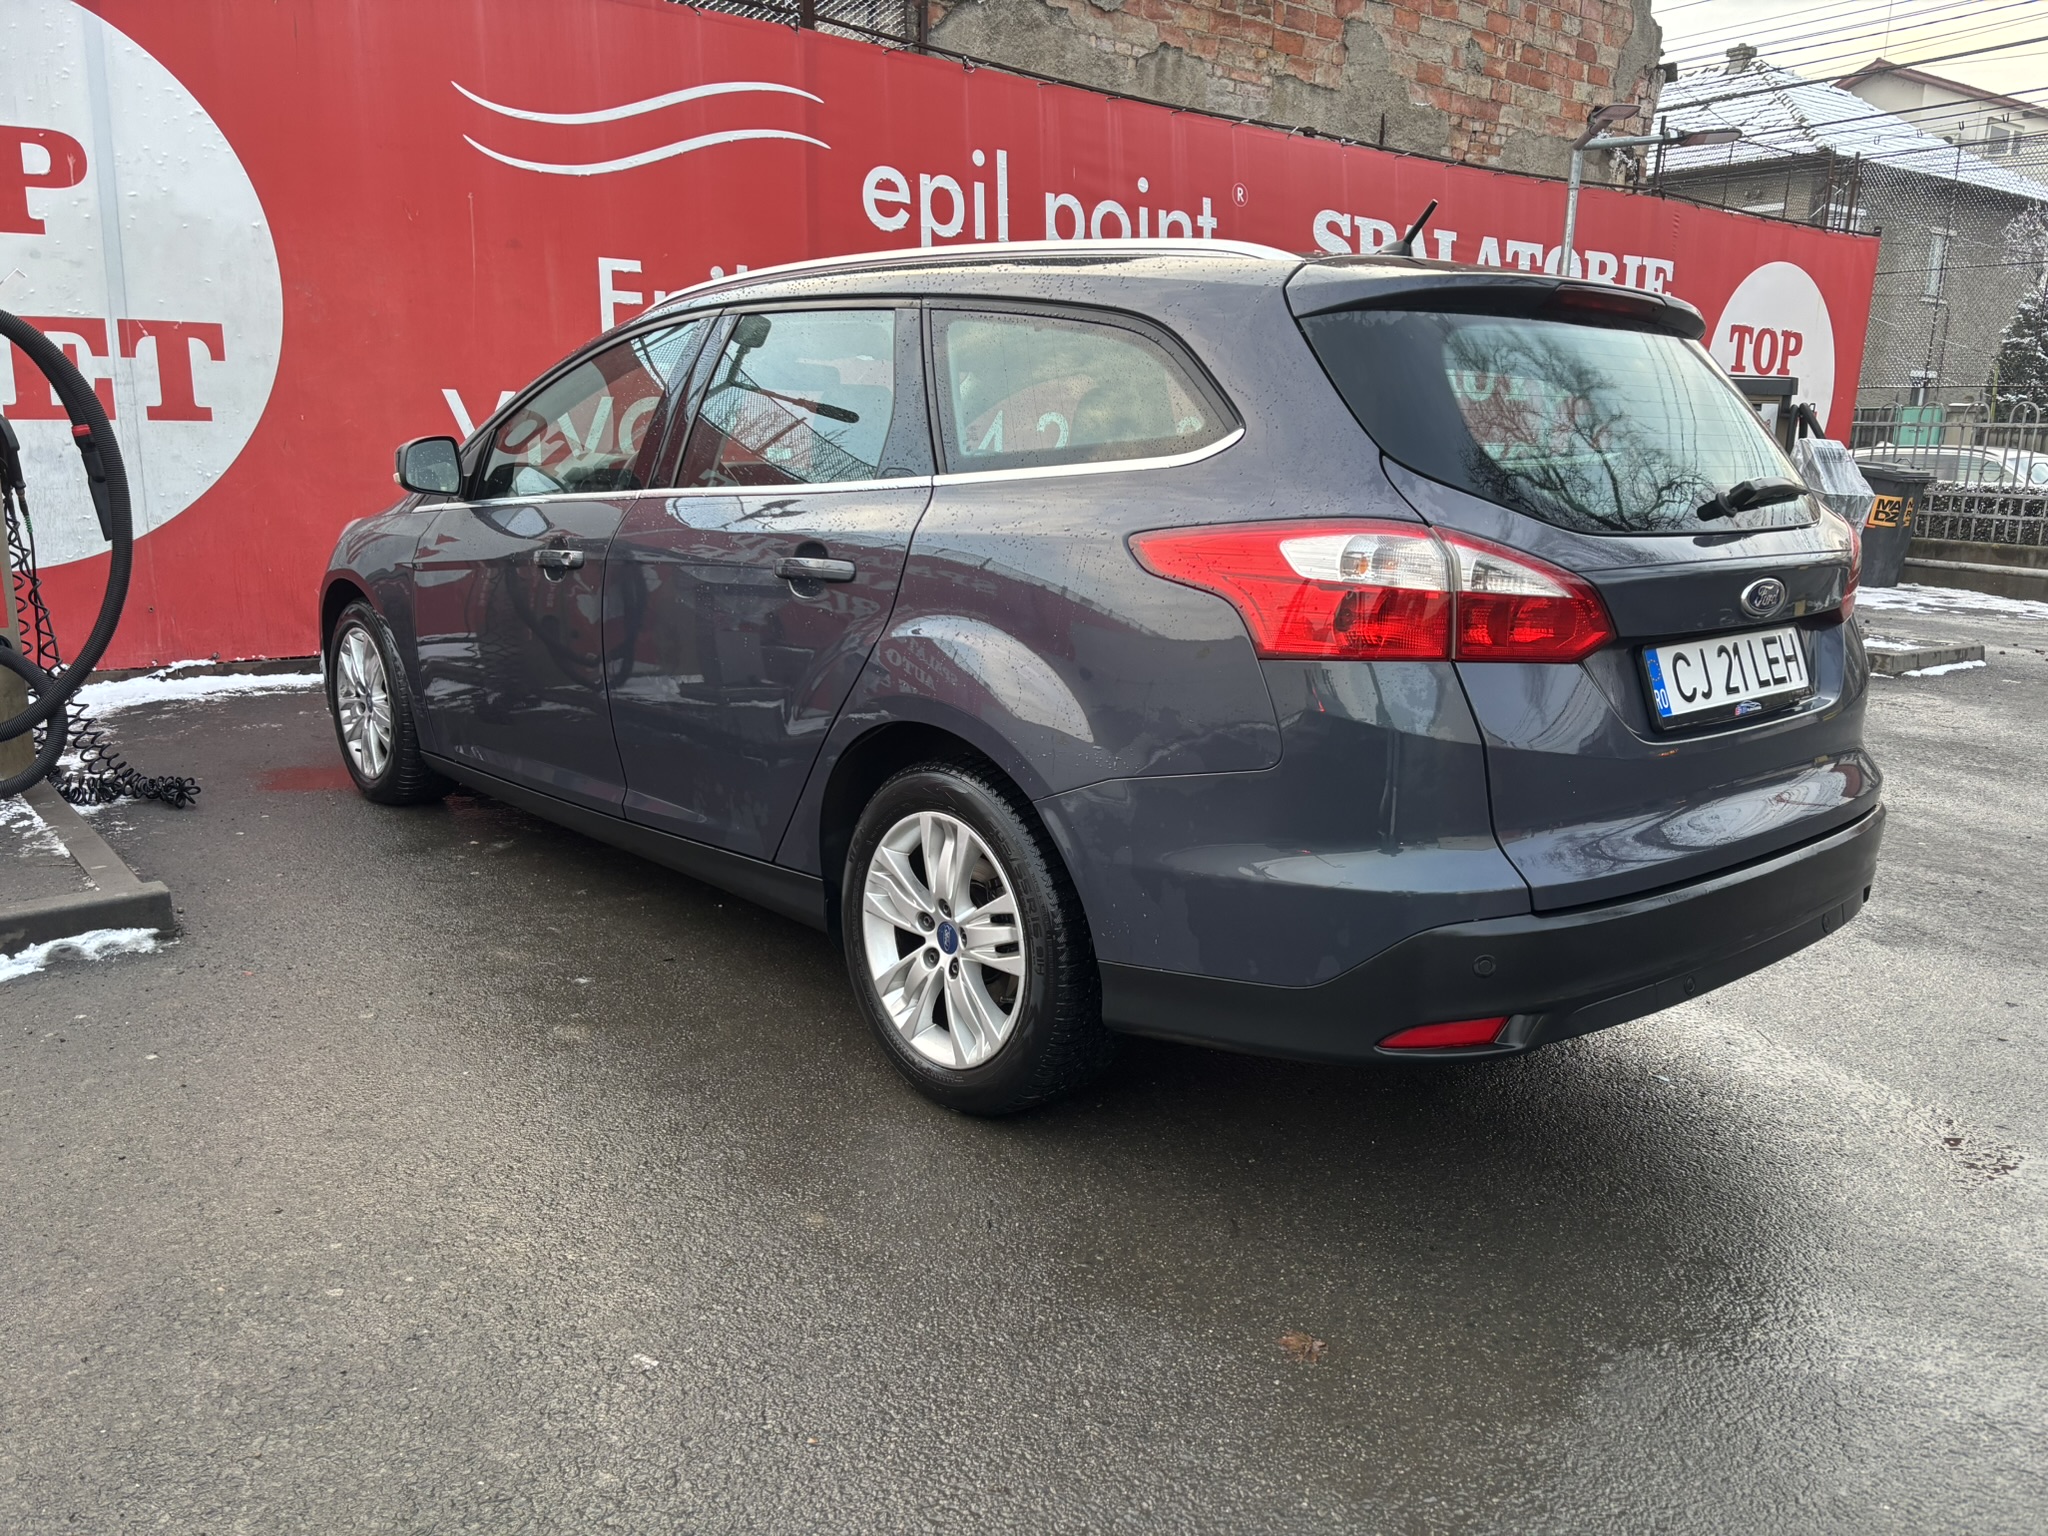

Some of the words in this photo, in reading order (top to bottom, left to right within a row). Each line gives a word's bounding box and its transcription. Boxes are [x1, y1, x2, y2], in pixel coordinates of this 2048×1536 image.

[862, 149, 1009, 248] epil
[1045, 177, 1218, 240] point
[1729, 323, 1803, 376] TOP
[1754, 585, 1780, 608] Ford
[1671, 648, 1714, 703] CJ
[1716, 644, 1750, 696] 21
[1746, 632, 1804, 690] LEH
[1654, 687, 1670, 709] RO
